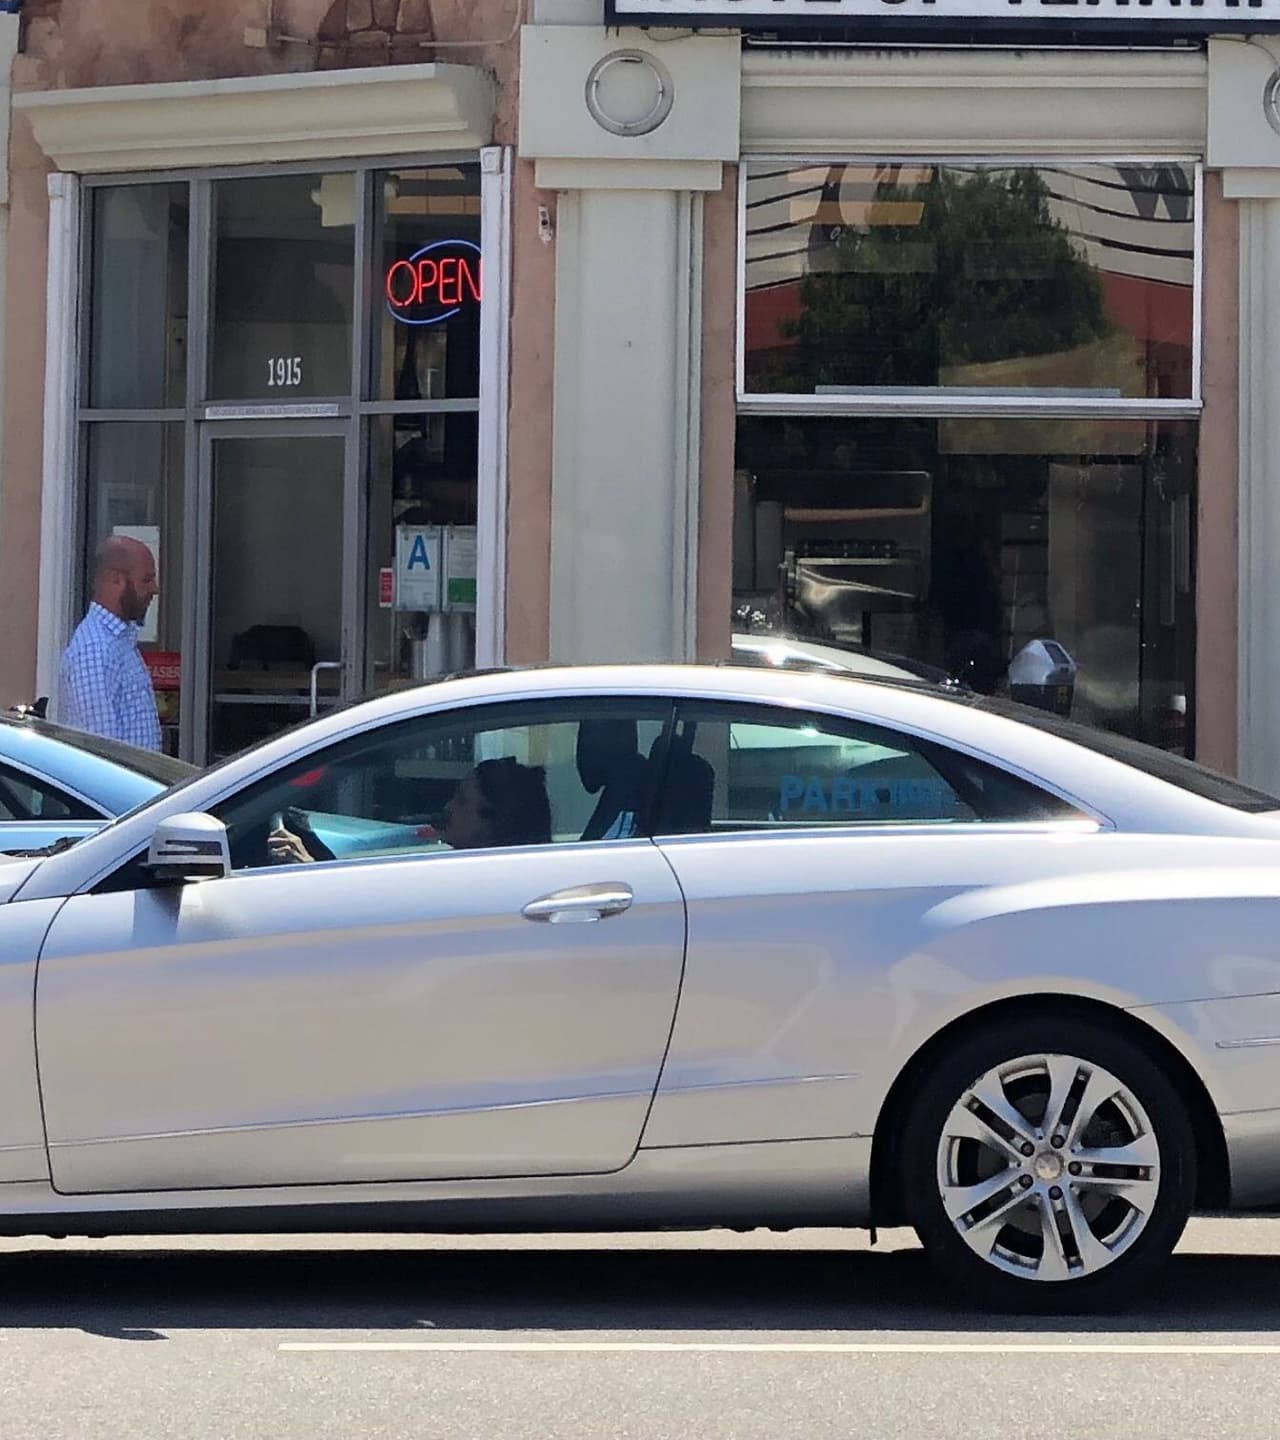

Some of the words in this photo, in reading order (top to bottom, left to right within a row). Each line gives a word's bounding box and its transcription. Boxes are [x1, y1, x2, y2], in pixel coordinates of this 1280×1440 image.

[385, 257, 483, 306] OPEN
[267, 357, 302, 386] 1915
[407, 534, 431, 570] A
